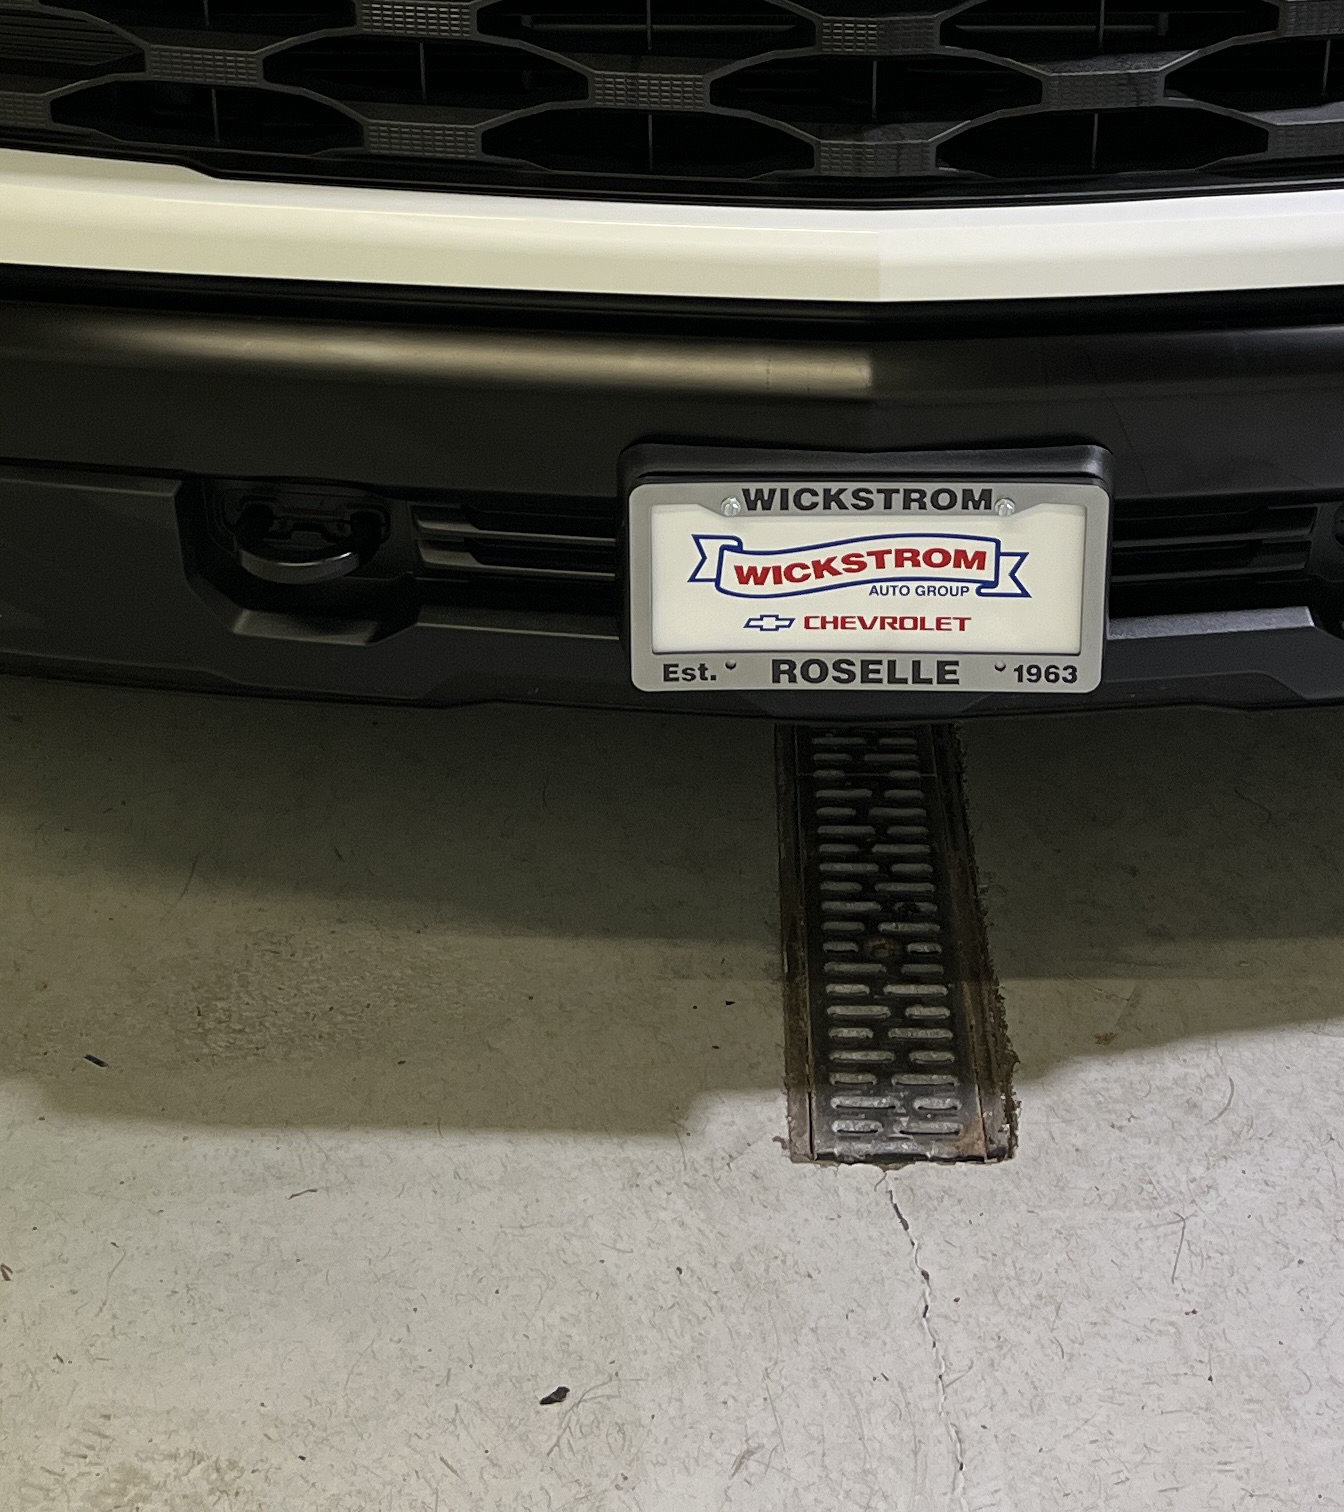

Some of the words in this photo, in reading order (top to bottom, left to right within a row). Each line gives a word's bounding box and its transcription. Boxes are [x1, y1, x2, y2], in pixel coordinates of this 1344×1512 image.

[741, 487, 993, 513] WICKSTROM
[733, 546, 989, 586] WICKSTROM
[869, 585, 911, 597] AUTO
[915, 585, 970, 598] GROUP
[803, 615, 973, 632] CHEVROLET
[662, 663, 717, 682] Est.
[771, 659, 960, 685] ROSELLE
[1013, 664, 1078, 683] 1963
